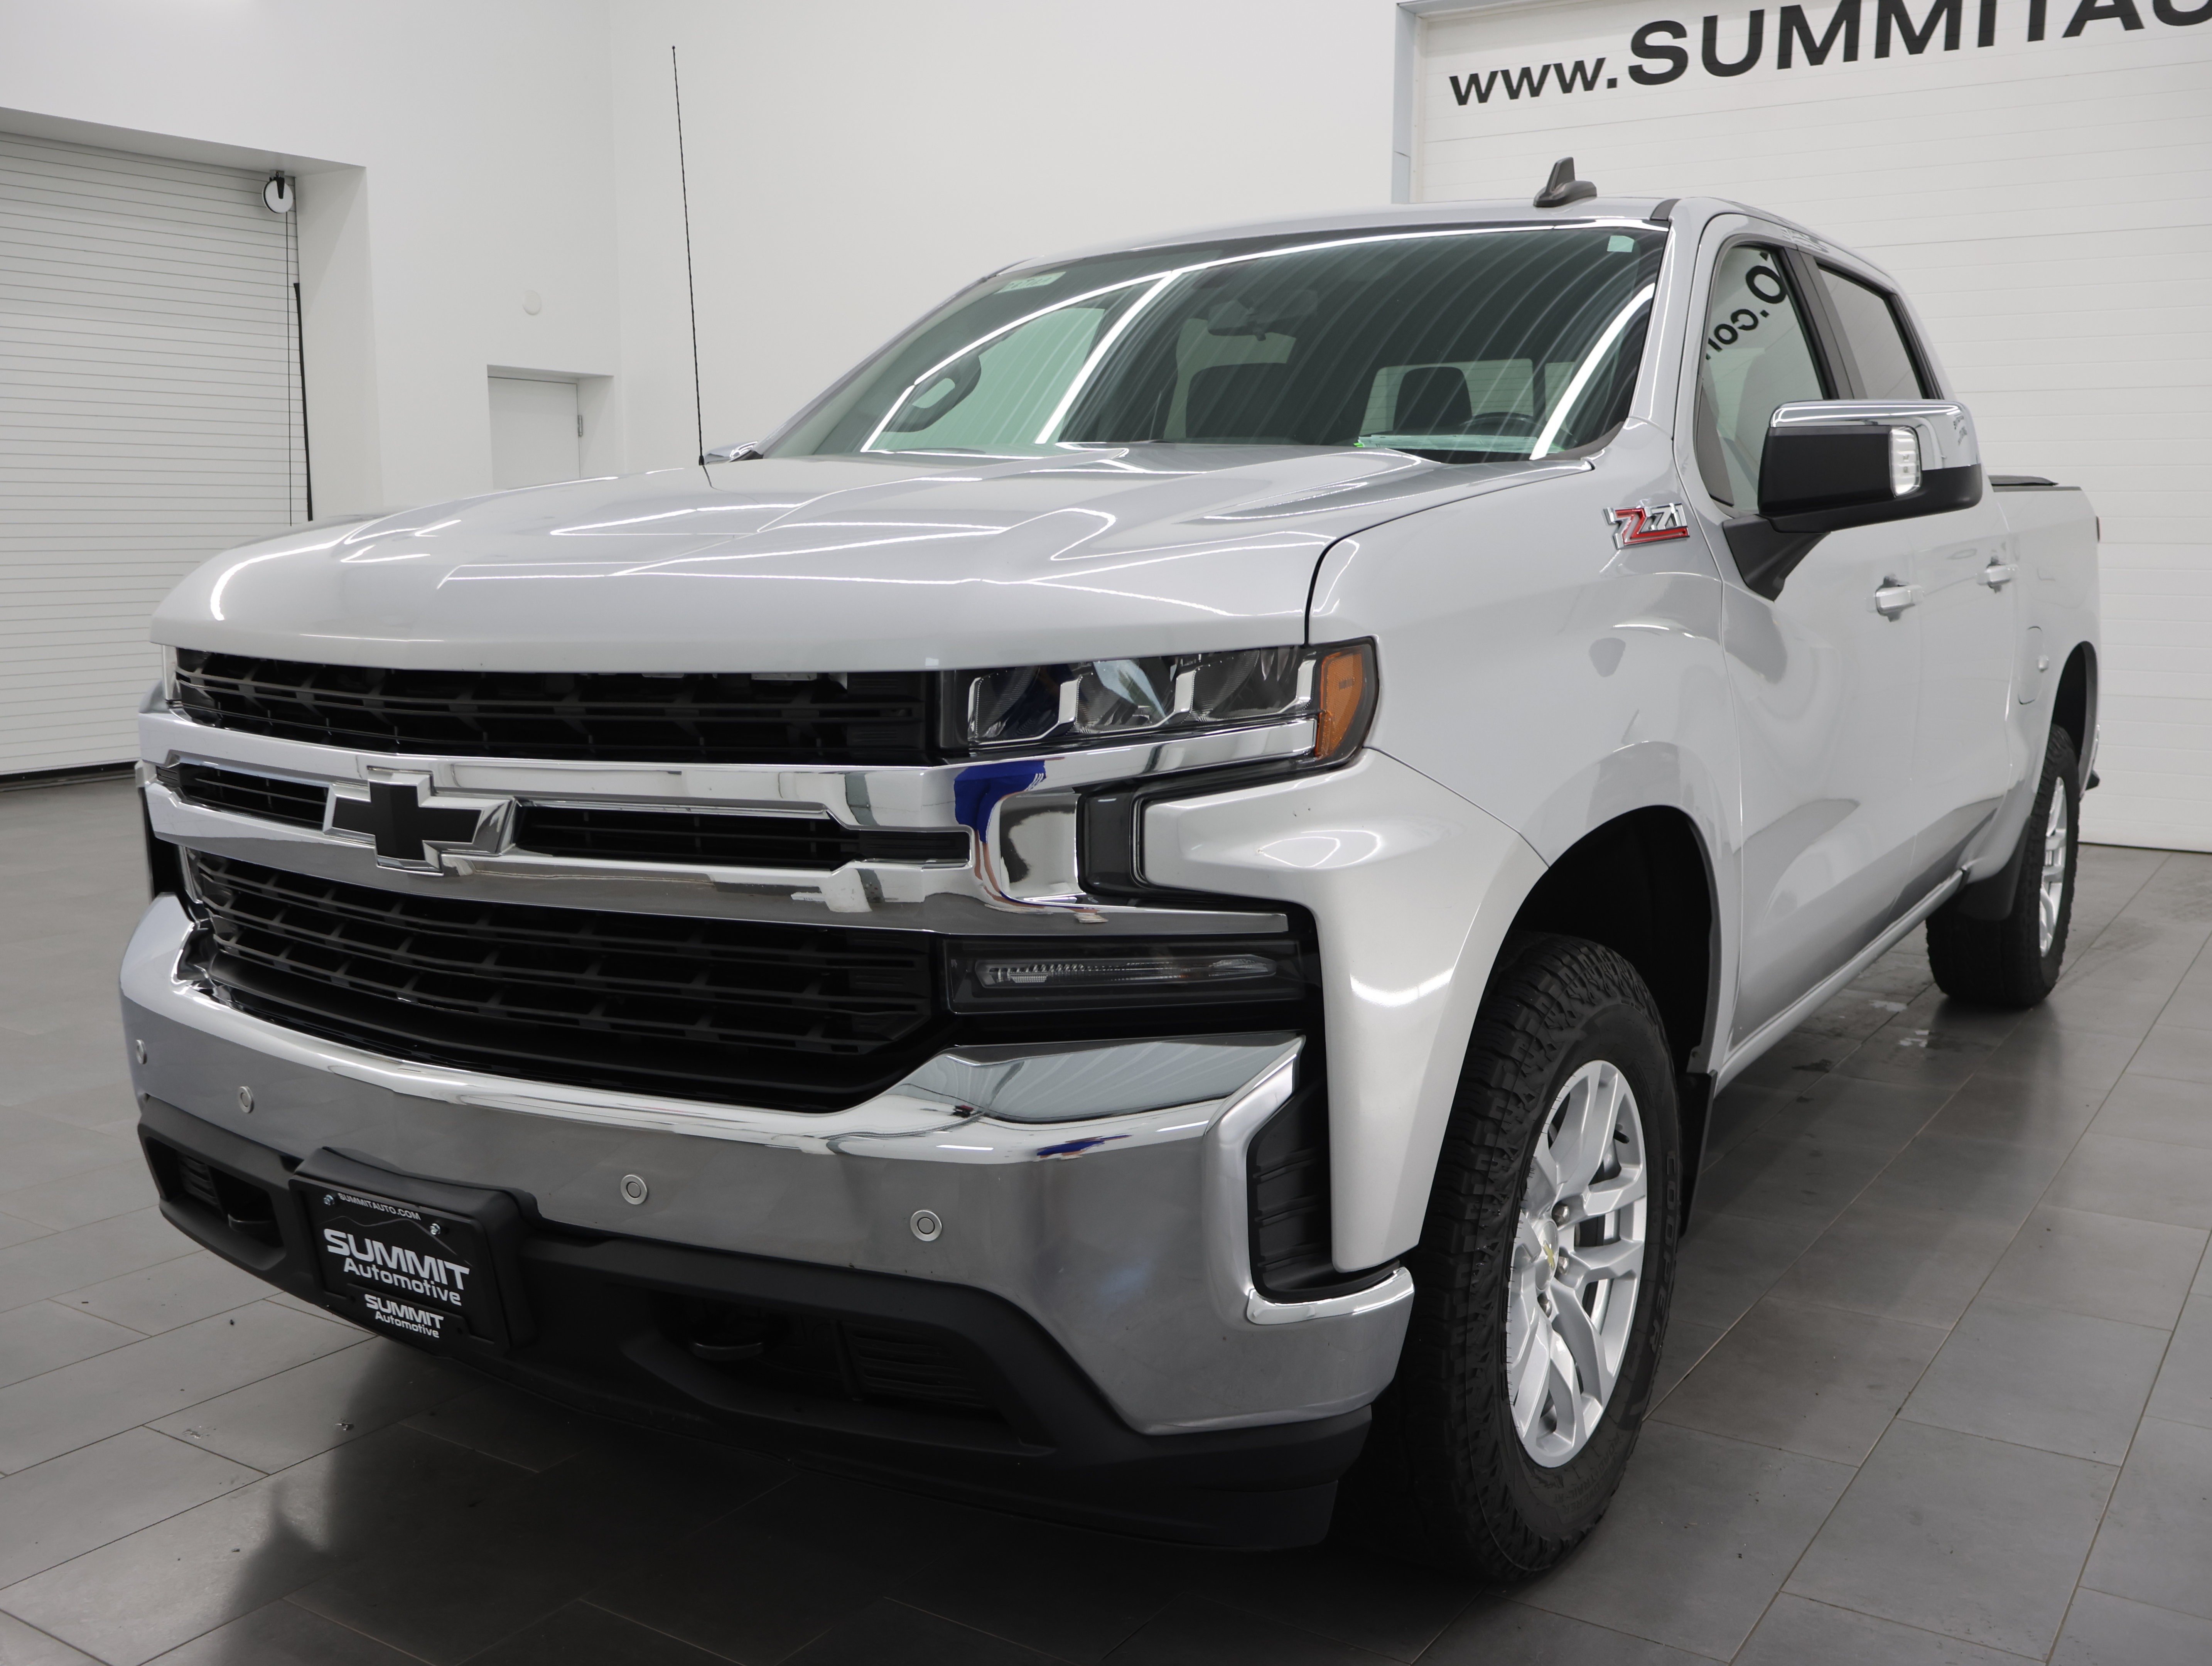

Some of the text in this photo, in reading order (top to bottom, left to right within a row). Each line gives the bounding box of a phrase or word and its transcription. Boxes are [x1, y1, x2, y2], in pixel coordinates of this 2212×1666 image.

[337, 1192, 421, 1221] SUMMITAUTO.COM
[323, 1228, 470, 1290] SUMMIT
[343, 1257, 462, 1306] Automotive
[364, 1294, 444, 1329] SUMMIT
[375, 1311, 440, 1338] Automotive
